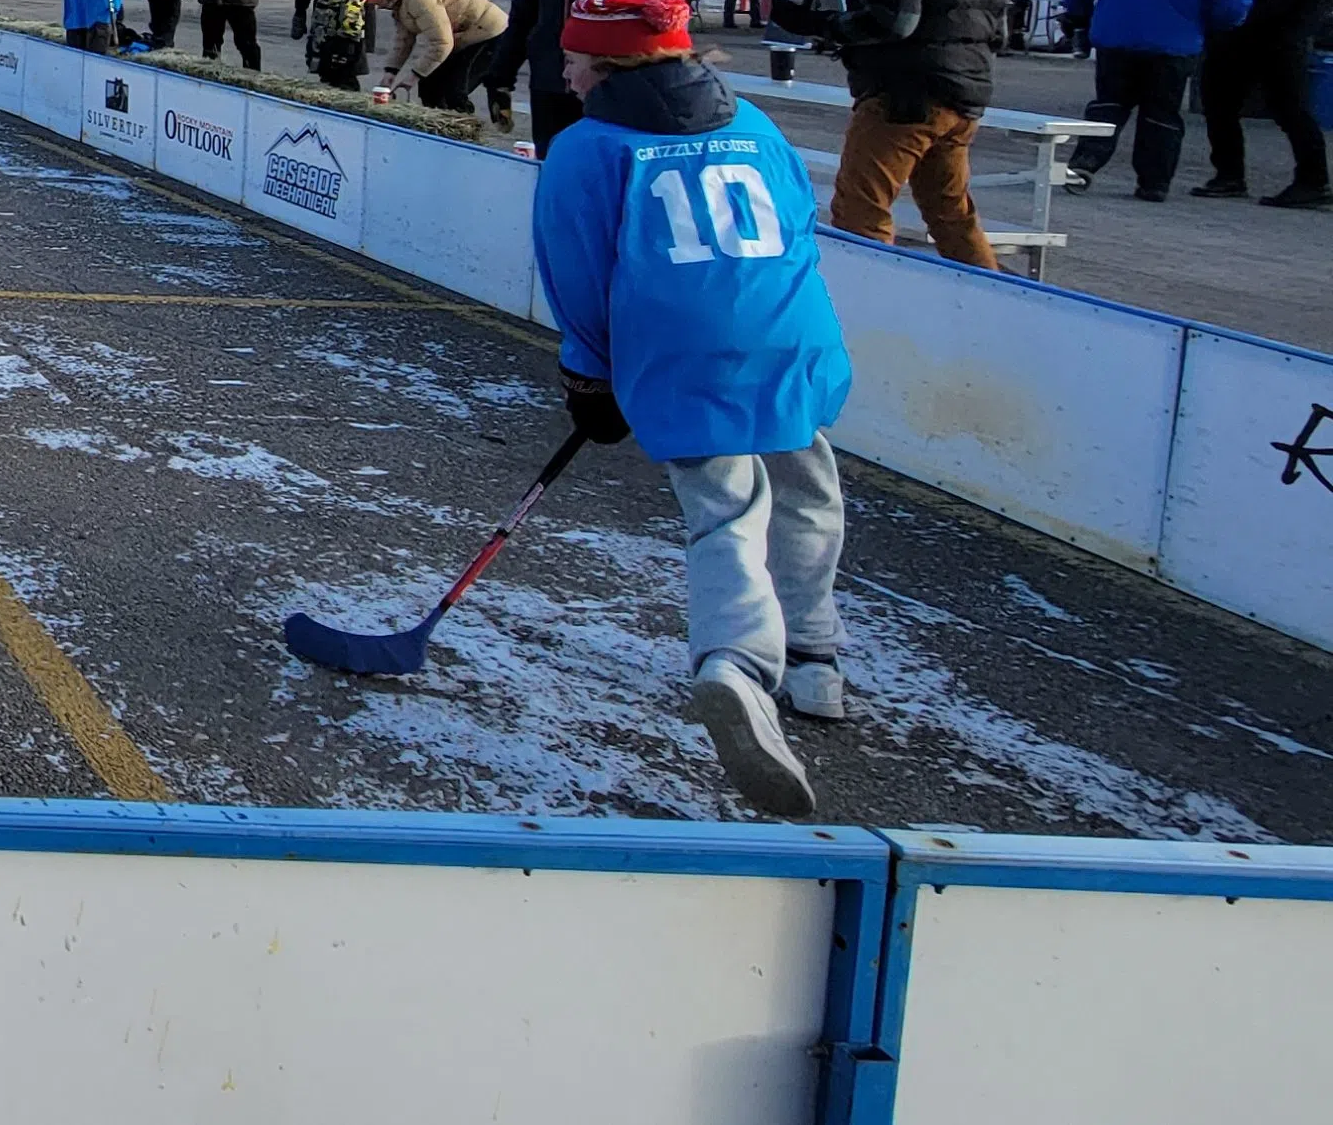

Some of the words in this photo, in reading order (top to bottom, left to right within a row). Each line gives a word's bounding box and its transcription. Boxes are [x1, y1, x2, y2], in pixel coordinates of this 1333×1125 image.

[86, 109, 145, 140] SILVERTIP
[164, 109, 233, 161] OUTLOOK
[177, 113, 198, 126] ROCKY
[199, 118, 234, 137] MOUNTAIN
[636, 141, 704, 162] GRIZZLY
[707, 139, 759, 154] HOUSE
[263, 176, 337, 220] MECHANICAL
[267, 152, 342, 201] CASCADE
[649, 164, 785, 265] 10
